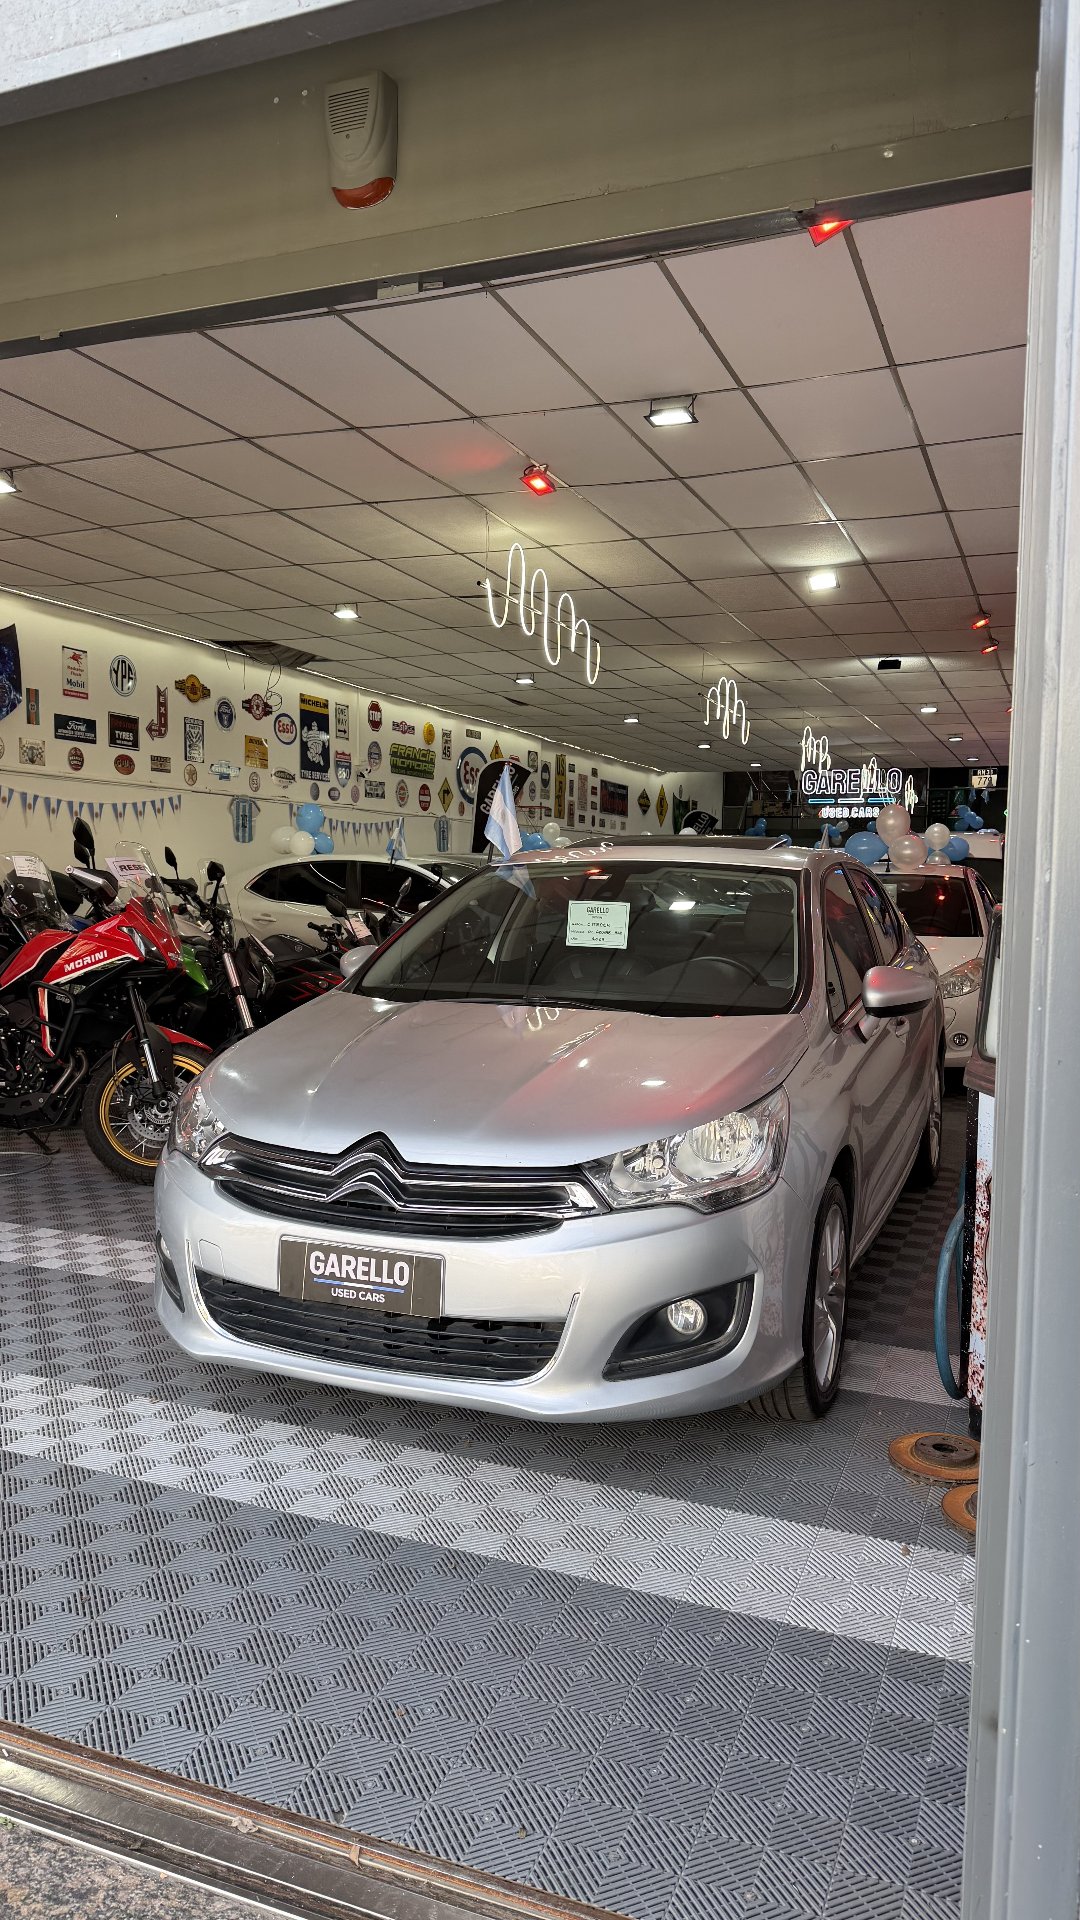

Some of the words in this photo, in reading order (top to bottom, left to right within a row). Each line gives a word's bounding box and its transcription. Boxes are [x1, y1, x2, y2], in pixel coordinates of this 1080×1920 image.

[113, 660, 133, 691] YPF
[66, 678, 85, 689] Mobil
[300, 698, 328, 709] MICHELIN
[338, 707, 347, 716] ONE
[370, 710, 381, 721] STOP
[66, 720, 87, 731] Ford
[338, 718, 347, 726] WAY
[115, 730, 134, 741] TYRES
[442, 745, 451, 758] 45
[390, 757, 435, 771] MOTORS
[555, 756, 565, 776] US
[463, 760, 480, 784] Ess
[802, 768, 902, 795] GARELLO
[821, 806, 849, 818] USED
[851, 806, 880, 818] CARS
[241, 815, 248, 828] 10
[693, 812, 711, 832] ELLO
[586, 906, 610, 914] GARELLO
[64, 950, 108, 973] MORINI
[309, 1250, 410, 1287] GARELLO
[331, 1287, 357, 1300] USED
[358, 1291, 386, 1304] CARS
